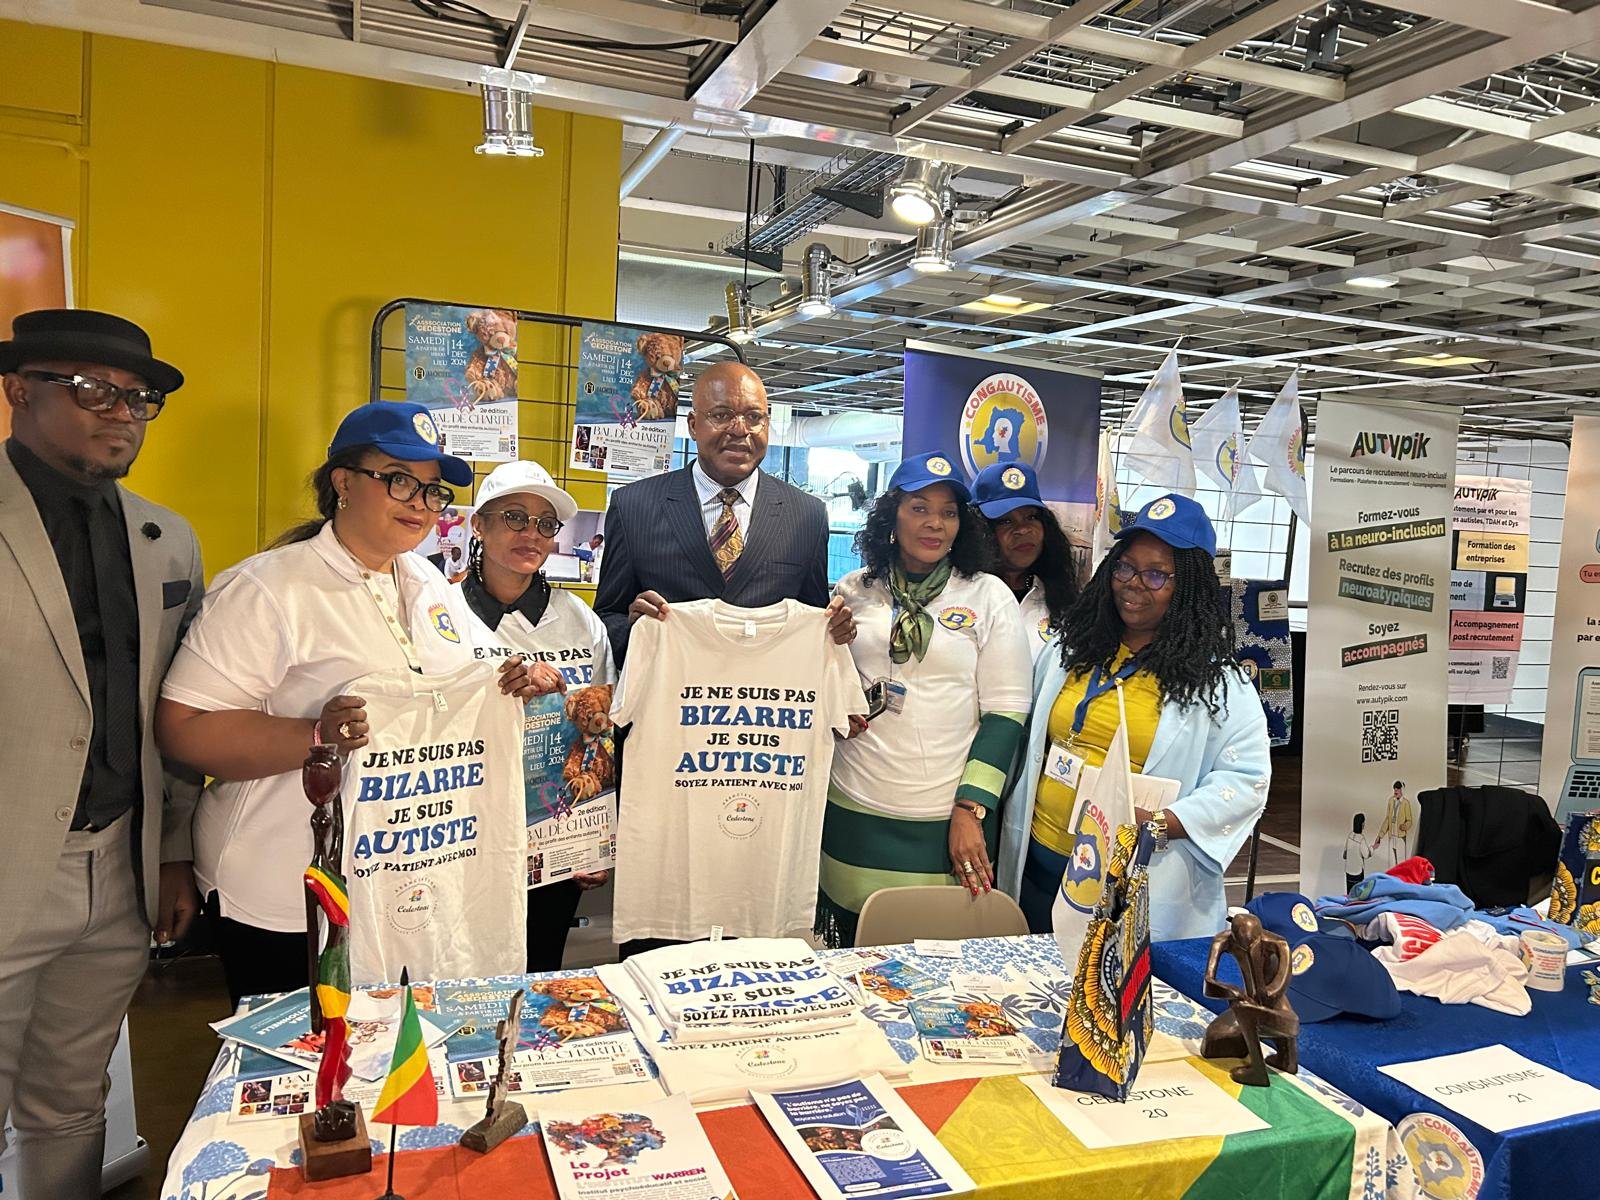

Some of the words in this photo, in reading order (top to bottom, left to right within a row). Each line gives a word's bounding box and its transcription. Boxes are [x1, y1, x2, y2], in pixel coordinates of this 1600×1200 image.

[408, 336, 445, 345] SAMEDI
[451, 340, 464, 350] 14
[582, 351, 616, 363] SAMEDI
[620, 359, 632, 369] 14
[966, 380, 1045, 425] CONGAUTISME
[1330, 465, 1338, 473] Le
[1338, 467, 1365, 476] parcours
[1373, 469, 1409, 478] recrutement
[1358, 507, 1420, 523] Formez-vous
[1460, 517, 1484, 525] autistes,
[1508, 520, 1518, 528] Dys
[1330, 534, 1339, 549] à
[1341, 533, 1353, 548] la
[1355, 522, 1444, 546] neuro-inclusion
[1467, 541, 1503, 550] Formation
[1503, 542, 1516, 551] des
[1466, 554, 1505, 564] entreprises
[1339, 558, 1381, 577] Recrutez
[1382, 567, 1402, 581] des
[1403, 573, 1435, 587] profils
[1341, 581, 1431, 608] neuroatypiques
[1454, 620, 1519, 630] Accompagnement
[1587, 617, 1596, 626] la
[1368, 623, 1400, 637] Soyez
[1453, 633, 1468, 642] post
[1470, 634, 1514, 642] recrutement
[1577, 634, 1593, 642] par
[559, 649, 592, 661] PAS
[1344, 636, 1425, 662] accompagnés
[680, 686, 702, 699] JE
[707, 686, 733, 699] NE
[737, 687, 780, 701] SUIS
[784, 689, 816, 703] PAS
[1358, 683, 1396, 692] Rendez-vous
[1356, 695, 1408, 705] www.autypik.com
[680, 705, 814, 729] BIZARRE
[550, 732, 562, 745] 14
[707, 733, 730, 746] JE
[737, 733, 780, 747] SUIS
[362, 752, 389, 768] JE
[392, 748, 415, 765] NE
[417, 743, 454, 763] SUIS
[456, 739, 485, 758] PAS
[550, 745, 565, 755] DEC
[548, 755, 565, 765] 2024
[675, 751, 806, 776] AUTISTE
[357, 762, 485, 802] BIZARRE
[675, 779, 708, 788] SOYEZ
[711, 779, 757, 788] PATIENT
[759, 781, 787, 791] AVEC
[788, 783, 803, 791] MOI
[387, 807, 411, 825] JE
[417, 800, 453, 820] SUIS
[353, 815, 478, 859] AUTISTE
[383, 858, 435, 872] PATIENT
[660, 968, 685, 980] JE
[689, 963, 721, 976] NE
[724, 960, 772, 970] SUIS
[776, 957, 815, 969] PAS
[663, 966, 828, 995] BIZARRE
[709, 992, 737, 1003] JE
[744, 986, 796, 1001] SUIS
[446, 1001, 503, 1013] SAMEDI
[683, 1009, 728, 1022] SOYEZ
[732, 1009, 789, 1018] PATIENT
[792, 1003, 828, 1014] AVEC
[830, 1000, 856, 1009] MOI
[711, 1038, 772, 1048] PATIENT
[775, 1035, 812, 1043] AVEC
[1435, 1069, 1544, 1096] CONGAUTISME
[1508, 1093, 1533, 1103] 21
[1142, 1108, 1168, 1118] 20
[570, 1161, 590, 1169] Le
[1424, 1117, 1482, 1200] CONGAUTISME
[573, 1168, 630, 1180] Projet
[652, 1167, 706, 1181] WARREN
